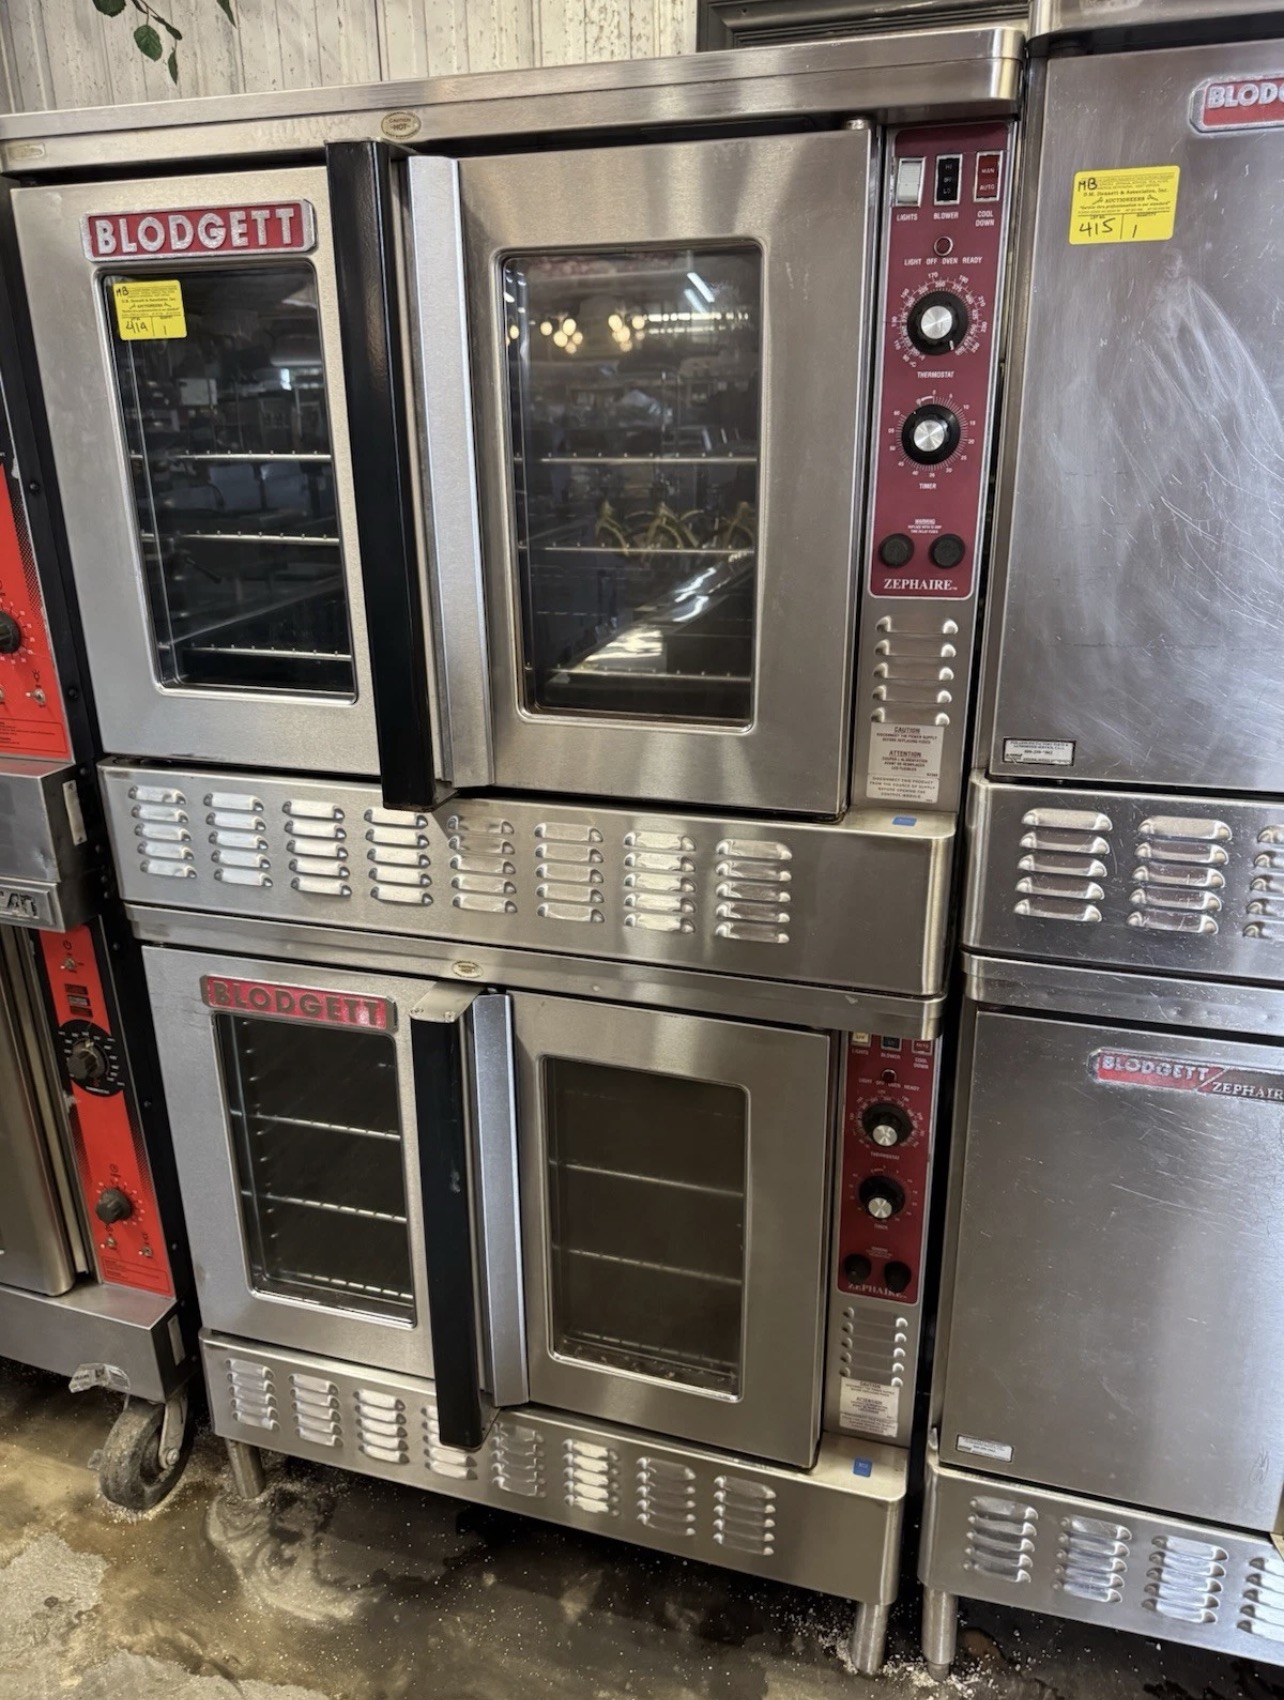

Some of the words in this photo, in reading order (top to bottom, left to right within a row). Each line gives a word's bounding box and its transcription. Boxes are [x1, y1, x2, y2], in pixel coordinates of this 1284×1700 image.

[934, 212, 959, 220] BLOWER
[977, 210, 994, 218] COOL
[95, 208, 294, 255] BLODGETT
[1079, 217, 1116, 237] 415
[1132, 224, 1138, 238] 1
[904, 258, 922, 266] LIGHT
[962, 256, 983, 264] READY
[884, 578, 952, 590] ZEPHAIRE
[894, 726, 920, 734] CAUTION
[213, 980, 379, 1026] BLODGETT
[1102, 1056, 1209, 1081] BLODGETT
